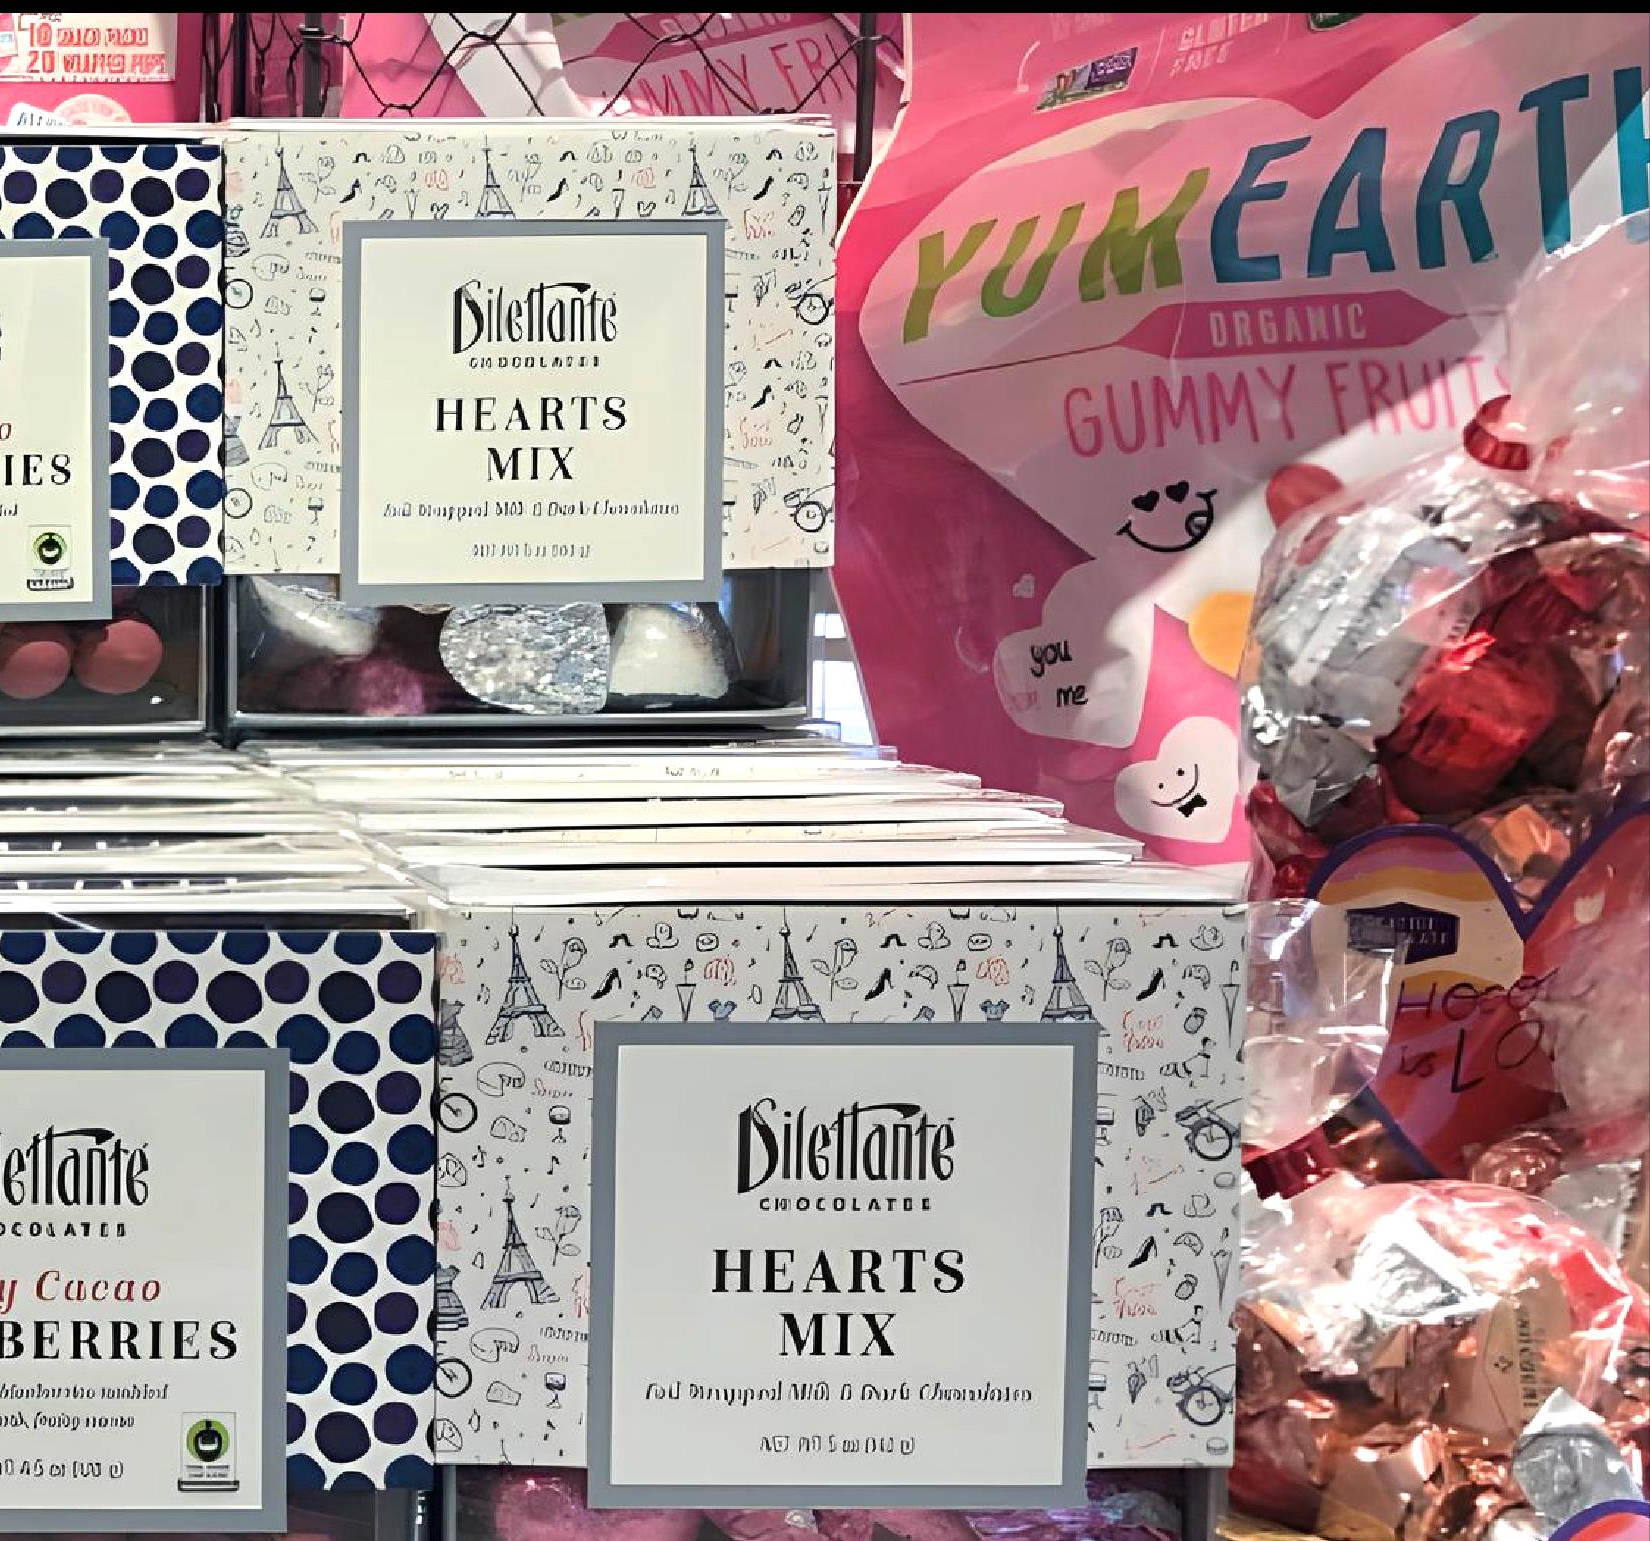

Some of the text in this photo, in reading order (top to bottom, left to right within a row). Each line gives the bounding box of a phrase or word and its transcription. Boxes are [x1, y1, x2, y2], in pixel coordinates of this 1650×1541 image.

[28, 21, 52, 47] 10
[26, 50, 56, 74] 20
[1209, 302, 1367, 349] ORGANIC
[434, 396, 628, 432] HEARTS
[1062, 362, 1297, 459] GUMMY
[486, 446, 575, 482] MIX
[1029, 640, 1073, 678] you
[1056, 684, 1089, 708] me
[35, 1269, 162, 1302] Cacao
[711, 1248, 966, 1295] HEARTS
[779, 1312, 898, 1357] MIX
